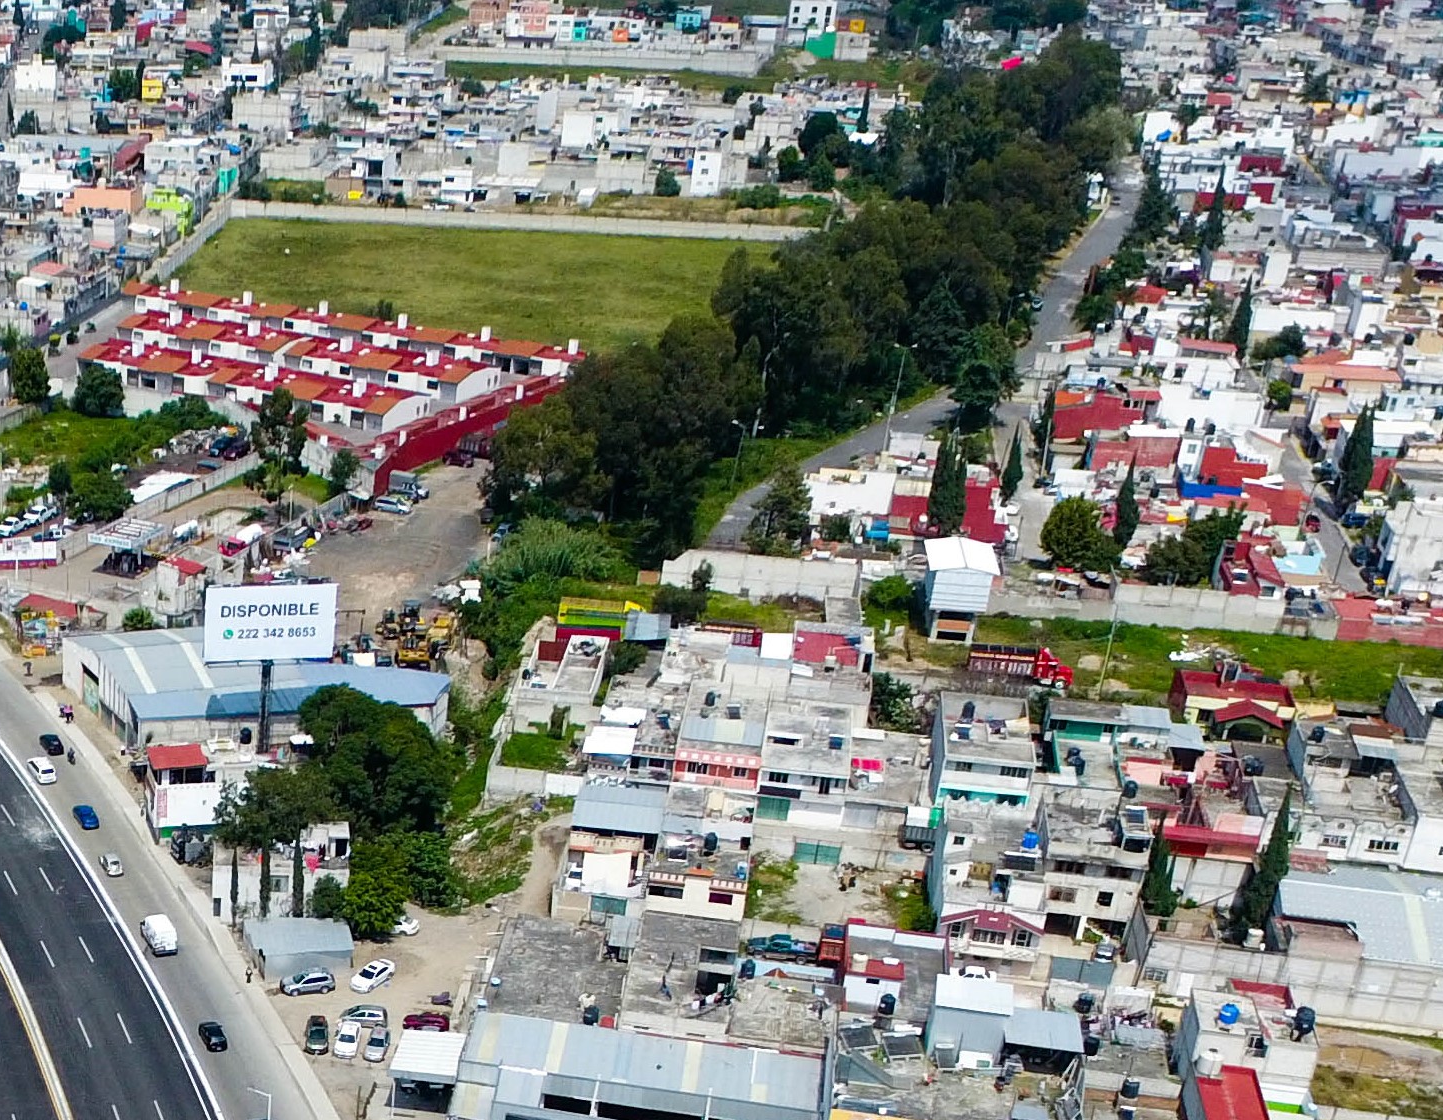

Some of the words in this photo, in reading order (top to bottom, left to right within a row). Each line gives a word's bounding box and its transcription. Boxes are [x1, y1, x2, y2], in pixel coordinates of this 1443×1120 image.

[220, 602, 319, 618] DISPONIBLE
[237, 628, 258, 639] 222
[263, 628, 284, 638] 342
[287, 626, 316, 637] 8653
